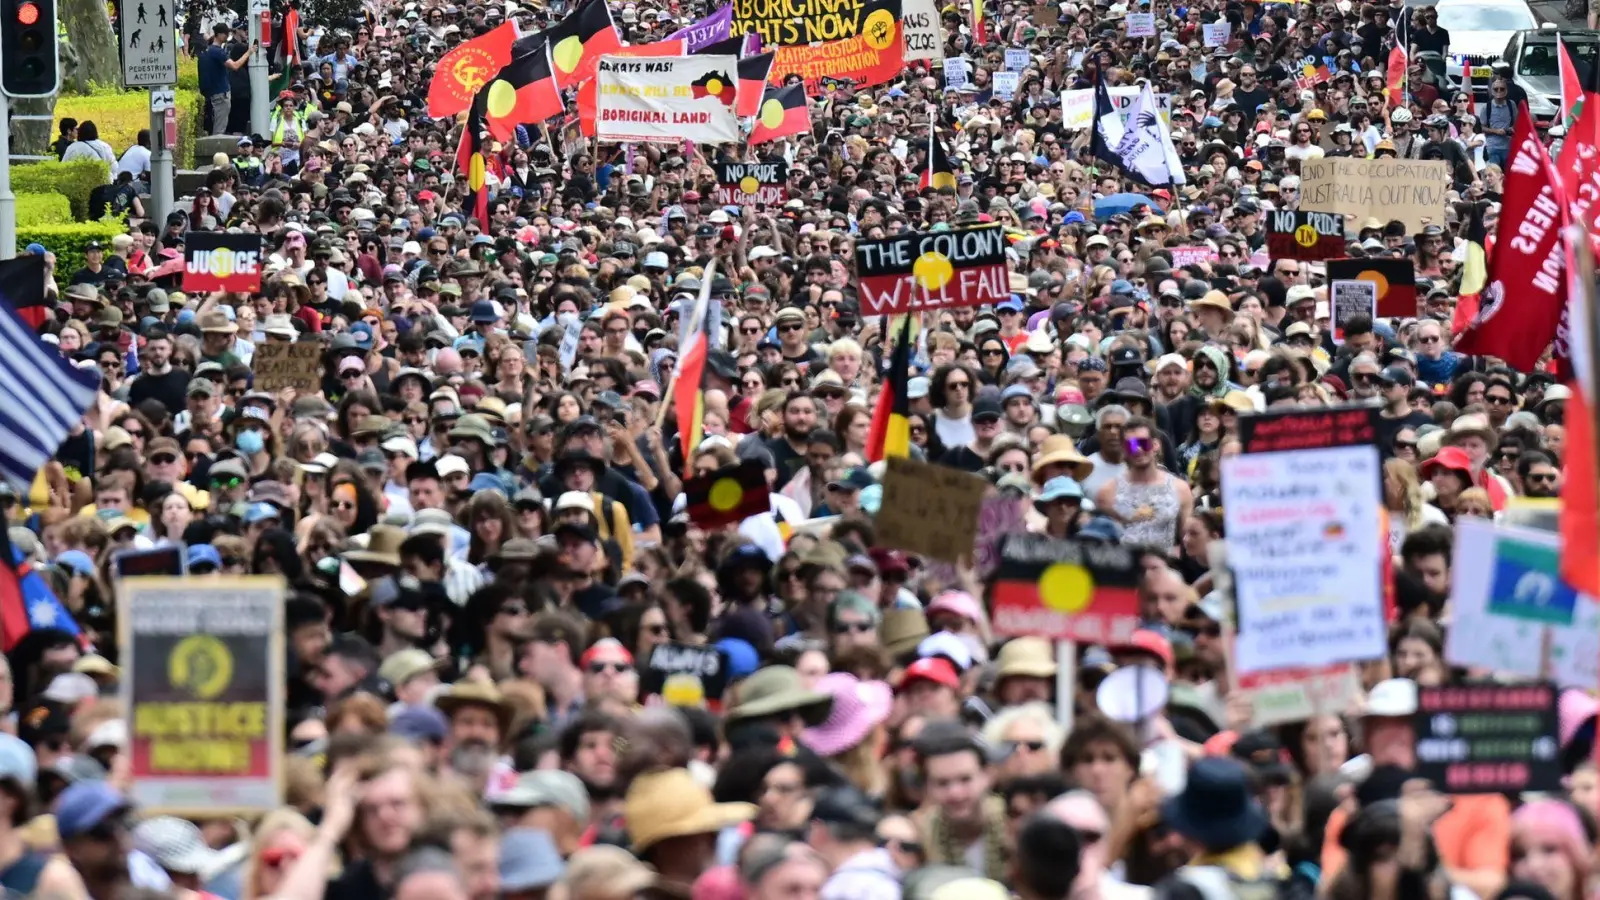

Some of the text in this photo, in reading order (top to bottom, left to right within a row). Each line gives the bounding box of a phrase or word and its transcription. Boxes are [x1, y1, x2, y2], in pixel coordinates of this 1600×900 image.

[729, 9, 860, 44] RIGHTS NOW
[775, 46, 812, 63] DEATHS
[821, 38, 864, 59] CUSTODY
[128, 65, 172, 73] PEDESTRIAN
[645, 61, 673, 73] WAS!
[1288, 54, 1316, 74] LAND
[133, 73, 168, 81] ACTIVITY
[1296, 72, 1323, 90] LIFE
[602, 108, 712, 125] BORIGINAL LAND!
[725, 163, 779, 183] NO PRIDE
[1301, 161, 1443, 182] END THE OCCUPATION
[719, 186, 785, 206] IN GENOCIDE
[1300, 182, 1444, 207] AUSTRALIA OUT NOW
[1274, 211, 1342, 237] NO PRIDE
[1298, 228, 1313, 244] IN
[856, 228, 1005, 269] THE COLONY
[186, 249, 259, 276] JUSTICE
[860, 266, 1011, 312] WILL FALL
